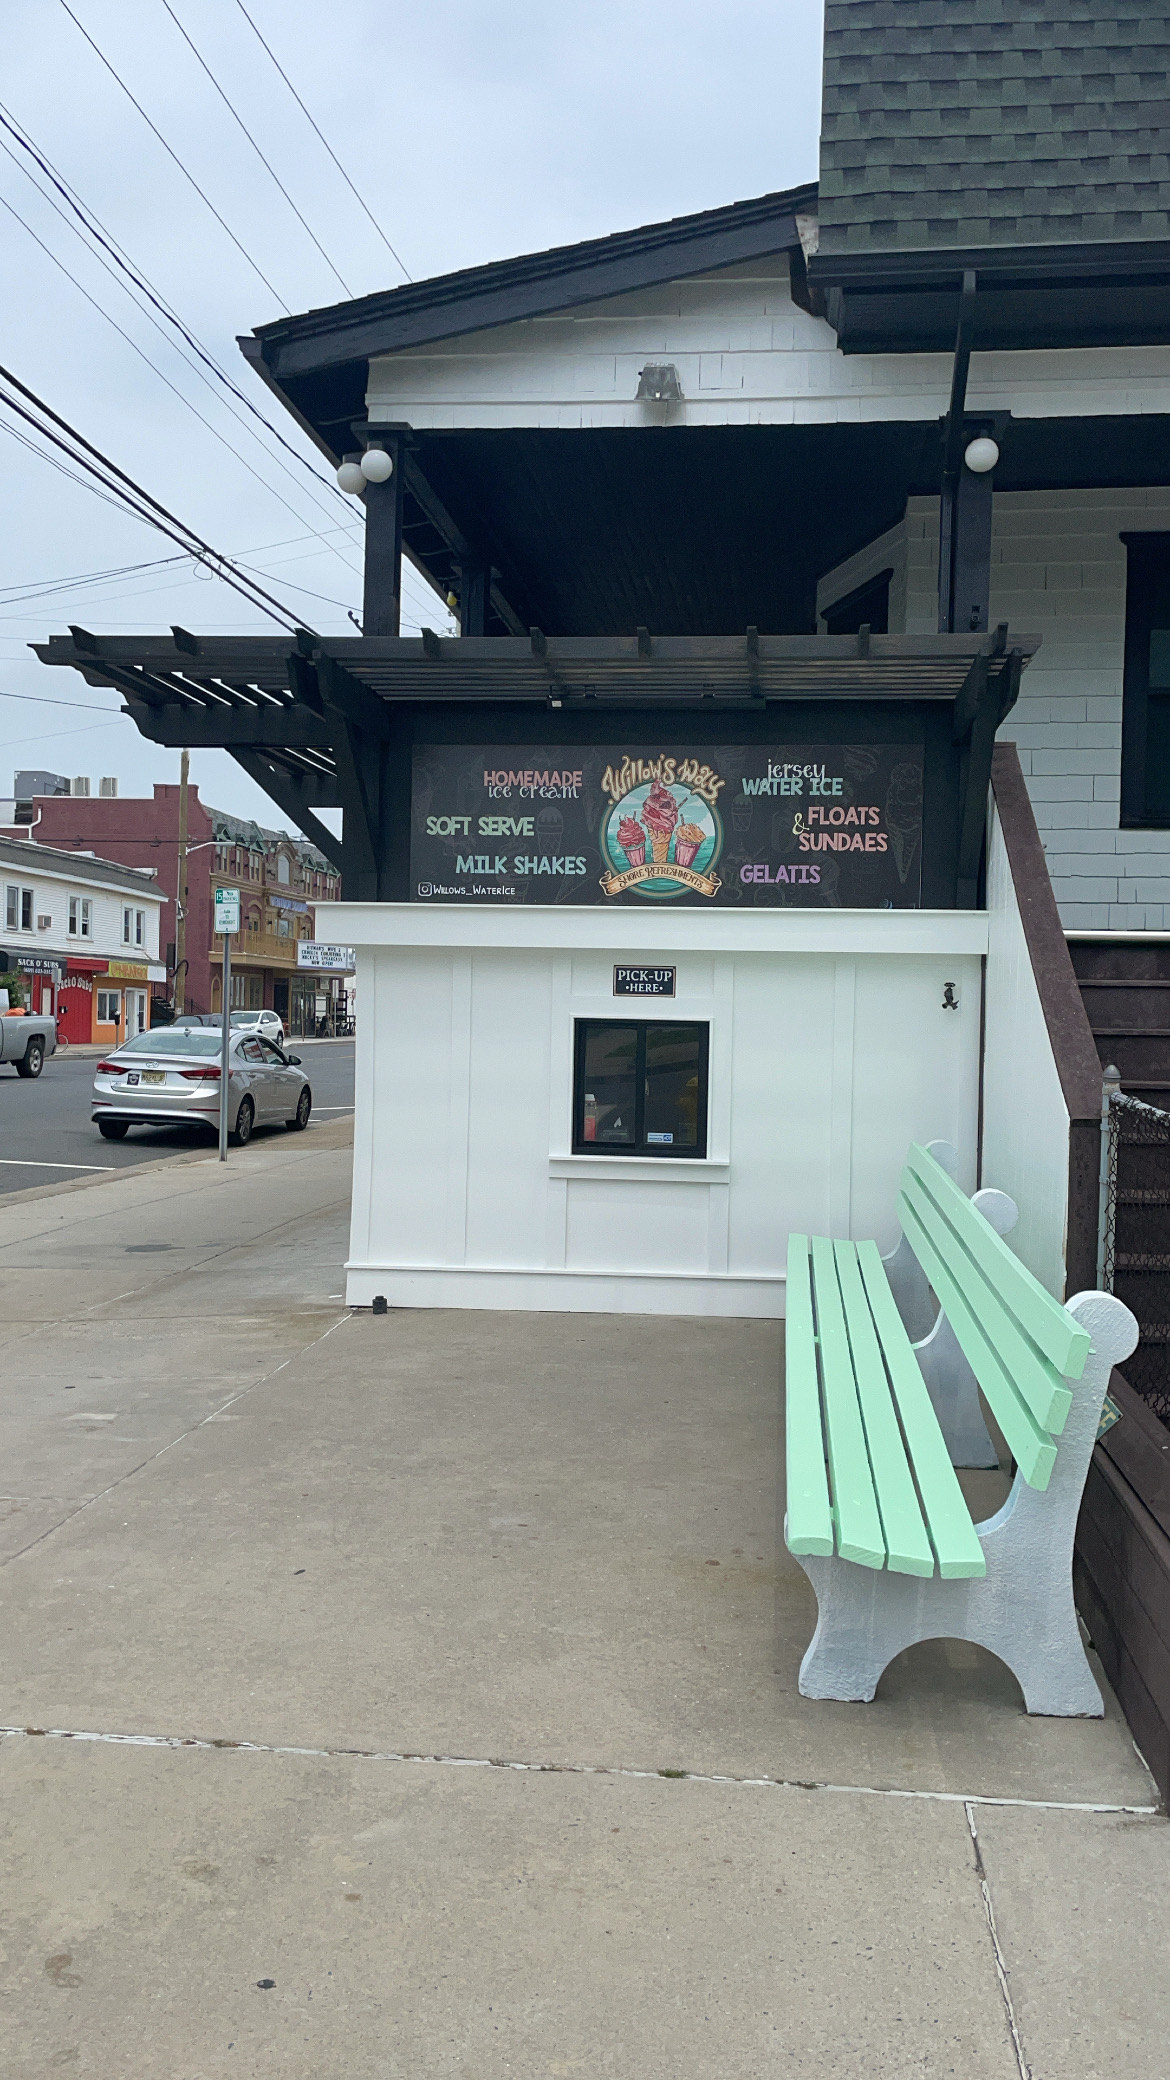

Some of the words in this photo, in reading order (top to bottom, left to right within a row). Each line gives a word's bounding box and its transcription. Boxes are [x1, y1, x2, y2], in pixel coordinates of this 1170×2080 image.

[483, 770, 583, 787] HOMEMADE
[601, 753, 677, 803] Willow's
[677, 758, 726, 804] Way
[767, 758, 826, 788] jersey
[488, 783, 512, 798] ice
[519, 784, 580, 799] cream
[741, 777, 803, 796] WATER
[809, 777, 844, 796] ICE
[792, 812, 810, 835] &
[807, 806, 880, 826] FLOATS
[426, 816, 472, 836] SOFT
[478, 816, 535, 837] SERVE
[798, 832, 889, 852] SUNDAES
[455, 855, 508, 874] MILK
[513, 856, 587, 875] SHAKES
[739, 864, 821, 884] GELATIS
[618, 869, 645, 888] SHORE
[645, 866, 704, 888] REFRESHMENTS
[216, 892, 223, 900] 15
[17, 958, 35, 967] SACK
[43, 960, 59, 969] SUBS
[617, 970, 673, 982] PICK-UP
